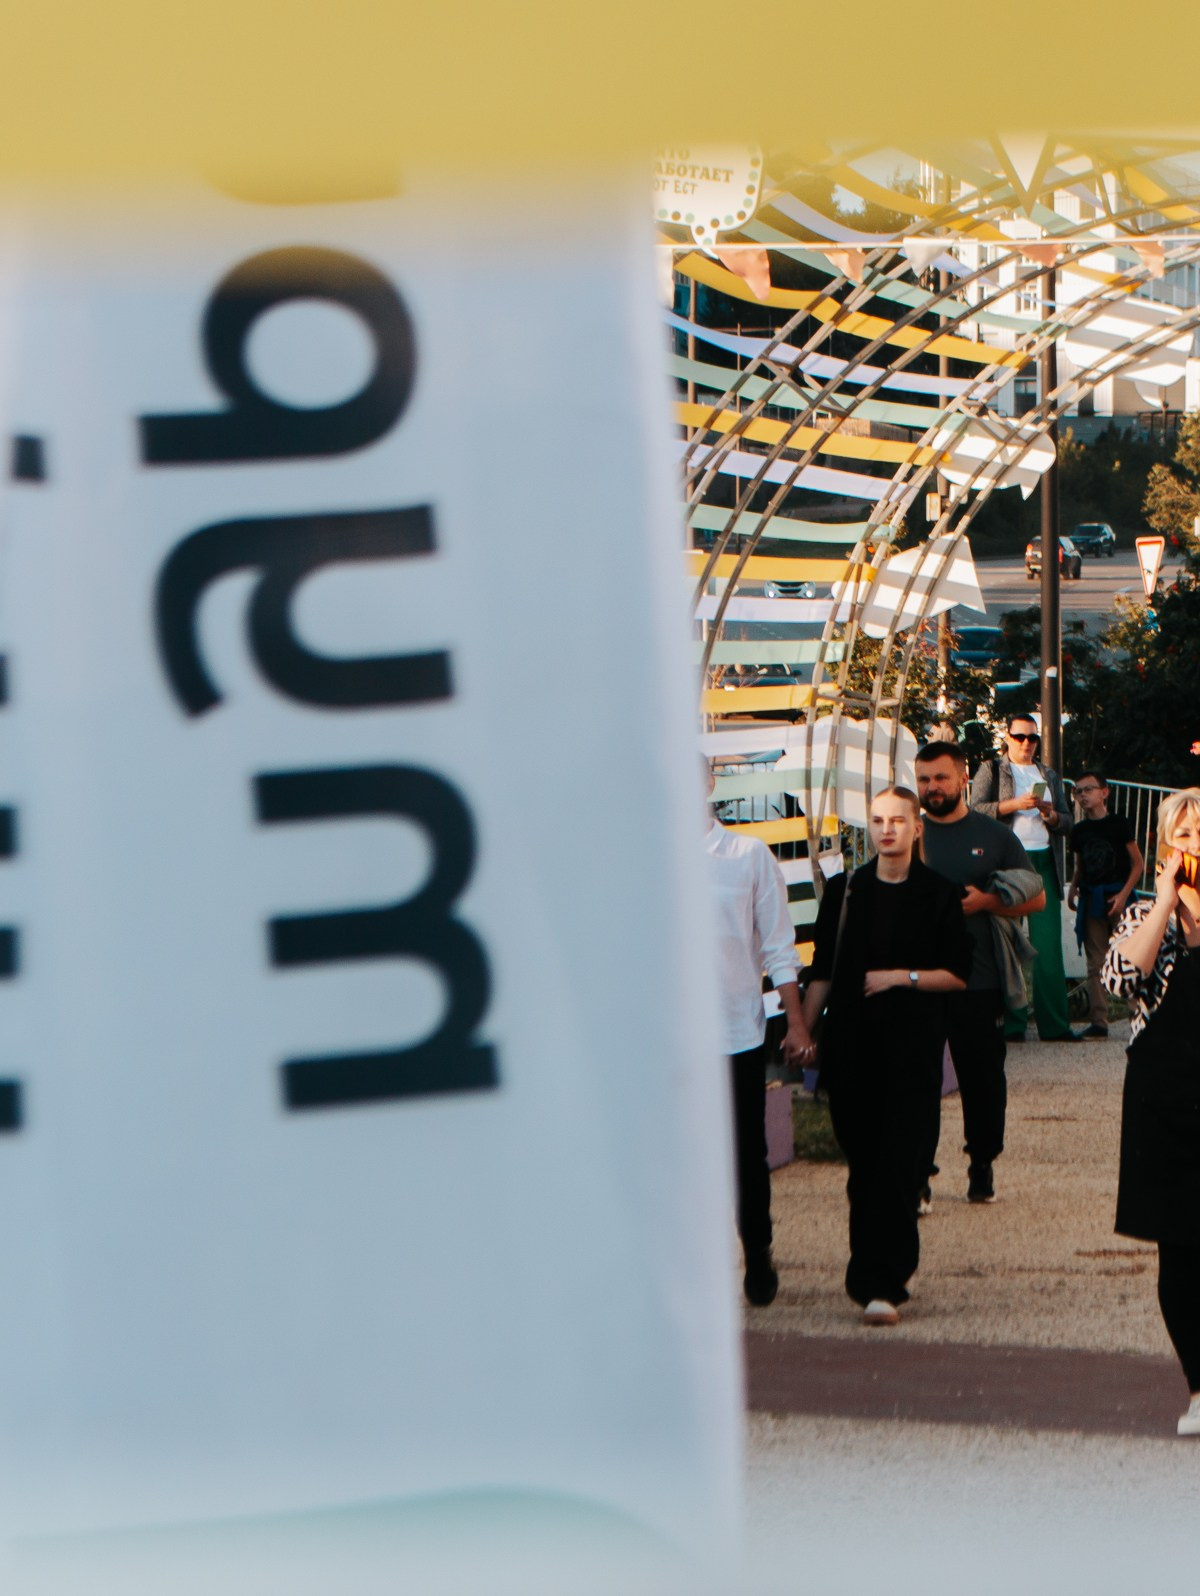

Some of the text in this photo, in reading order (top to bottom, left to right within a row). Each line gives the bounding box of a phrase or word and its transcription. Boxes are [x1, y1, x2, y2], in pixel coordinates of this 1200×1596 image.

[653, 162, 734, 183] АБОТАЕТ
[652, 178, 699, 195] ОТ ЕСТ
